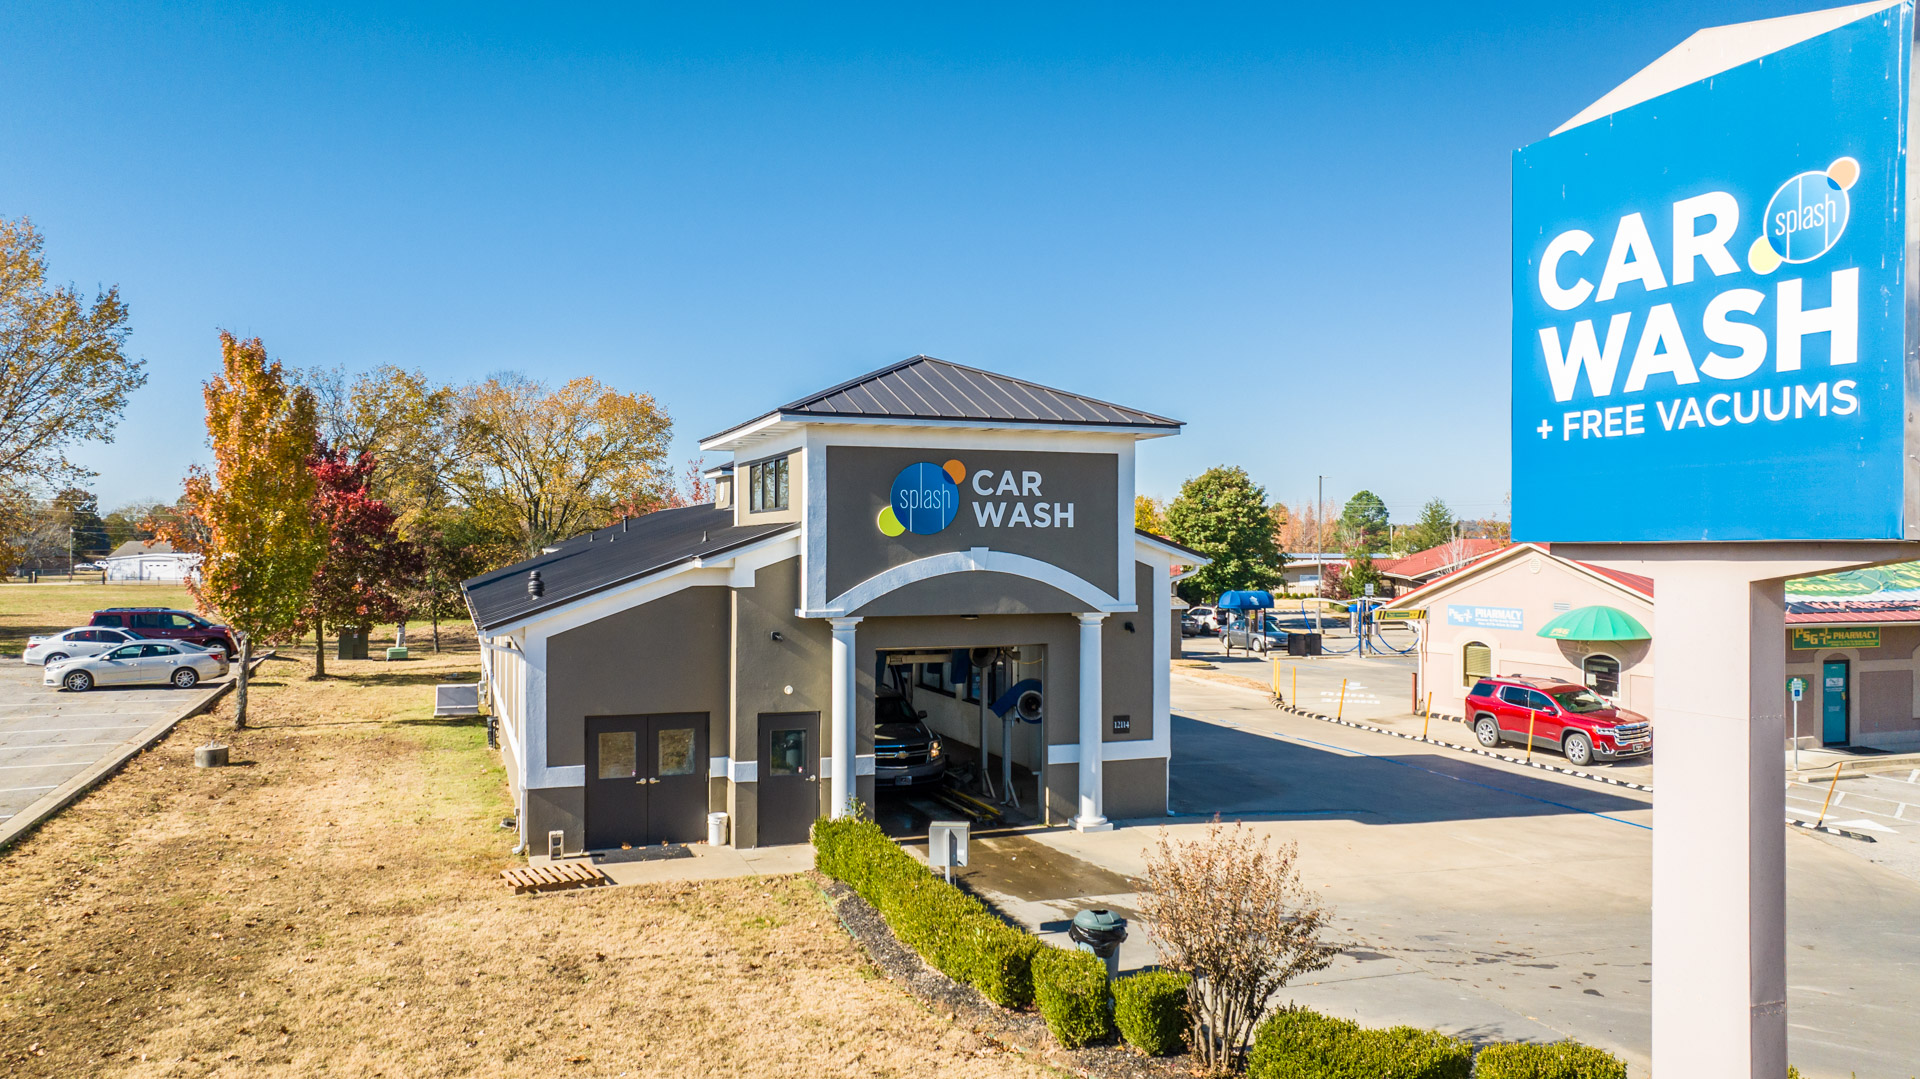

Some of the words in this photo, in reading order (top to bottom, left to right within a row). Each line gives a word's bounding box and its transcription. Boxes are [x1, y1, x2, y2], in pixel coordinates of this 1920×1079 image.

[1774, 177, 1836, 259] splash
[1538, 191, 1740, 311] CAR
[1538, 267, 1859, 403] WASH
[1562, 403, 1645, 441] FREE
[1656, 380, 1858, 431] VACUUMS
[900, 463, 950, 532] splash
[972, 469, 1042, 496] CAR
[972, 502, 1074, 528] WASH
[1475, 608, 1521, 620] PHARMACY
[1796, 628, 1818, 645] PSG
[1833, 631, 1877, 639] PHARMACY
